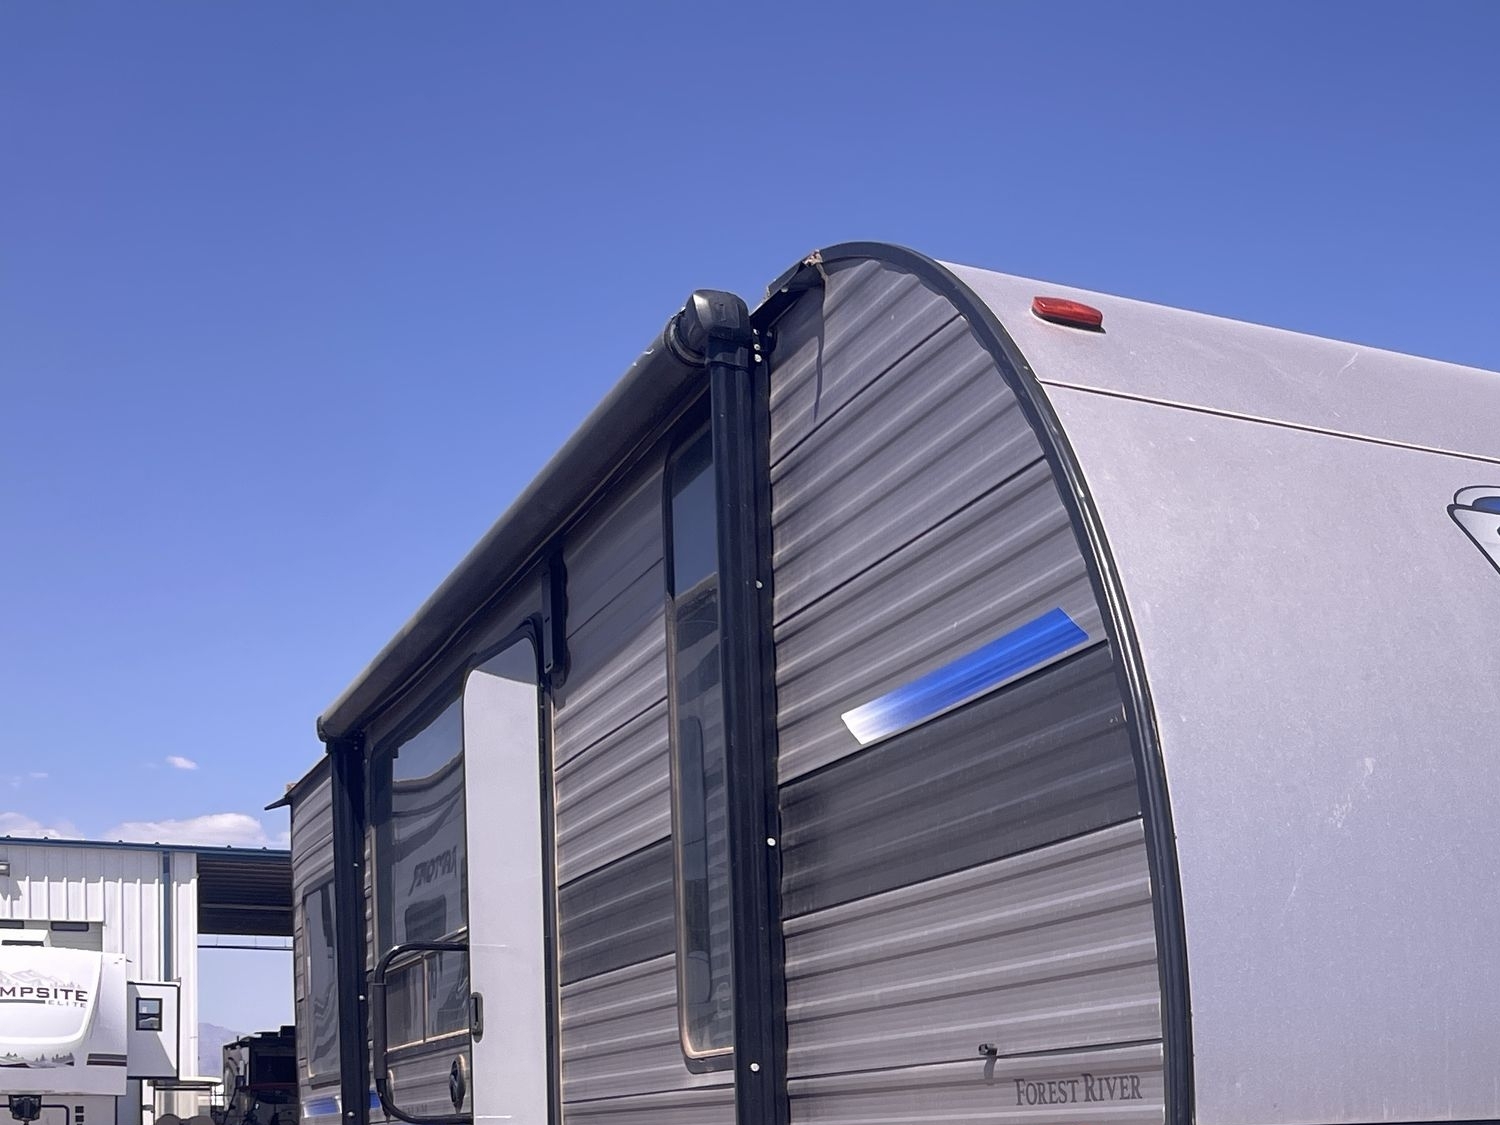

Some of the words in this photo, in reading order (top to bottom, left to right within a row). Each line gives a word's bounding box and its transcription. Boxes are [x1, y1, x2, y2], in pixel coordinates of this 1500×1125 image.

[48, 1000, 87, 1008] ELITE
[1013, 1078, 1080, 1106] FOREST
[1081, 1072, 1143, 1102] RIVER
